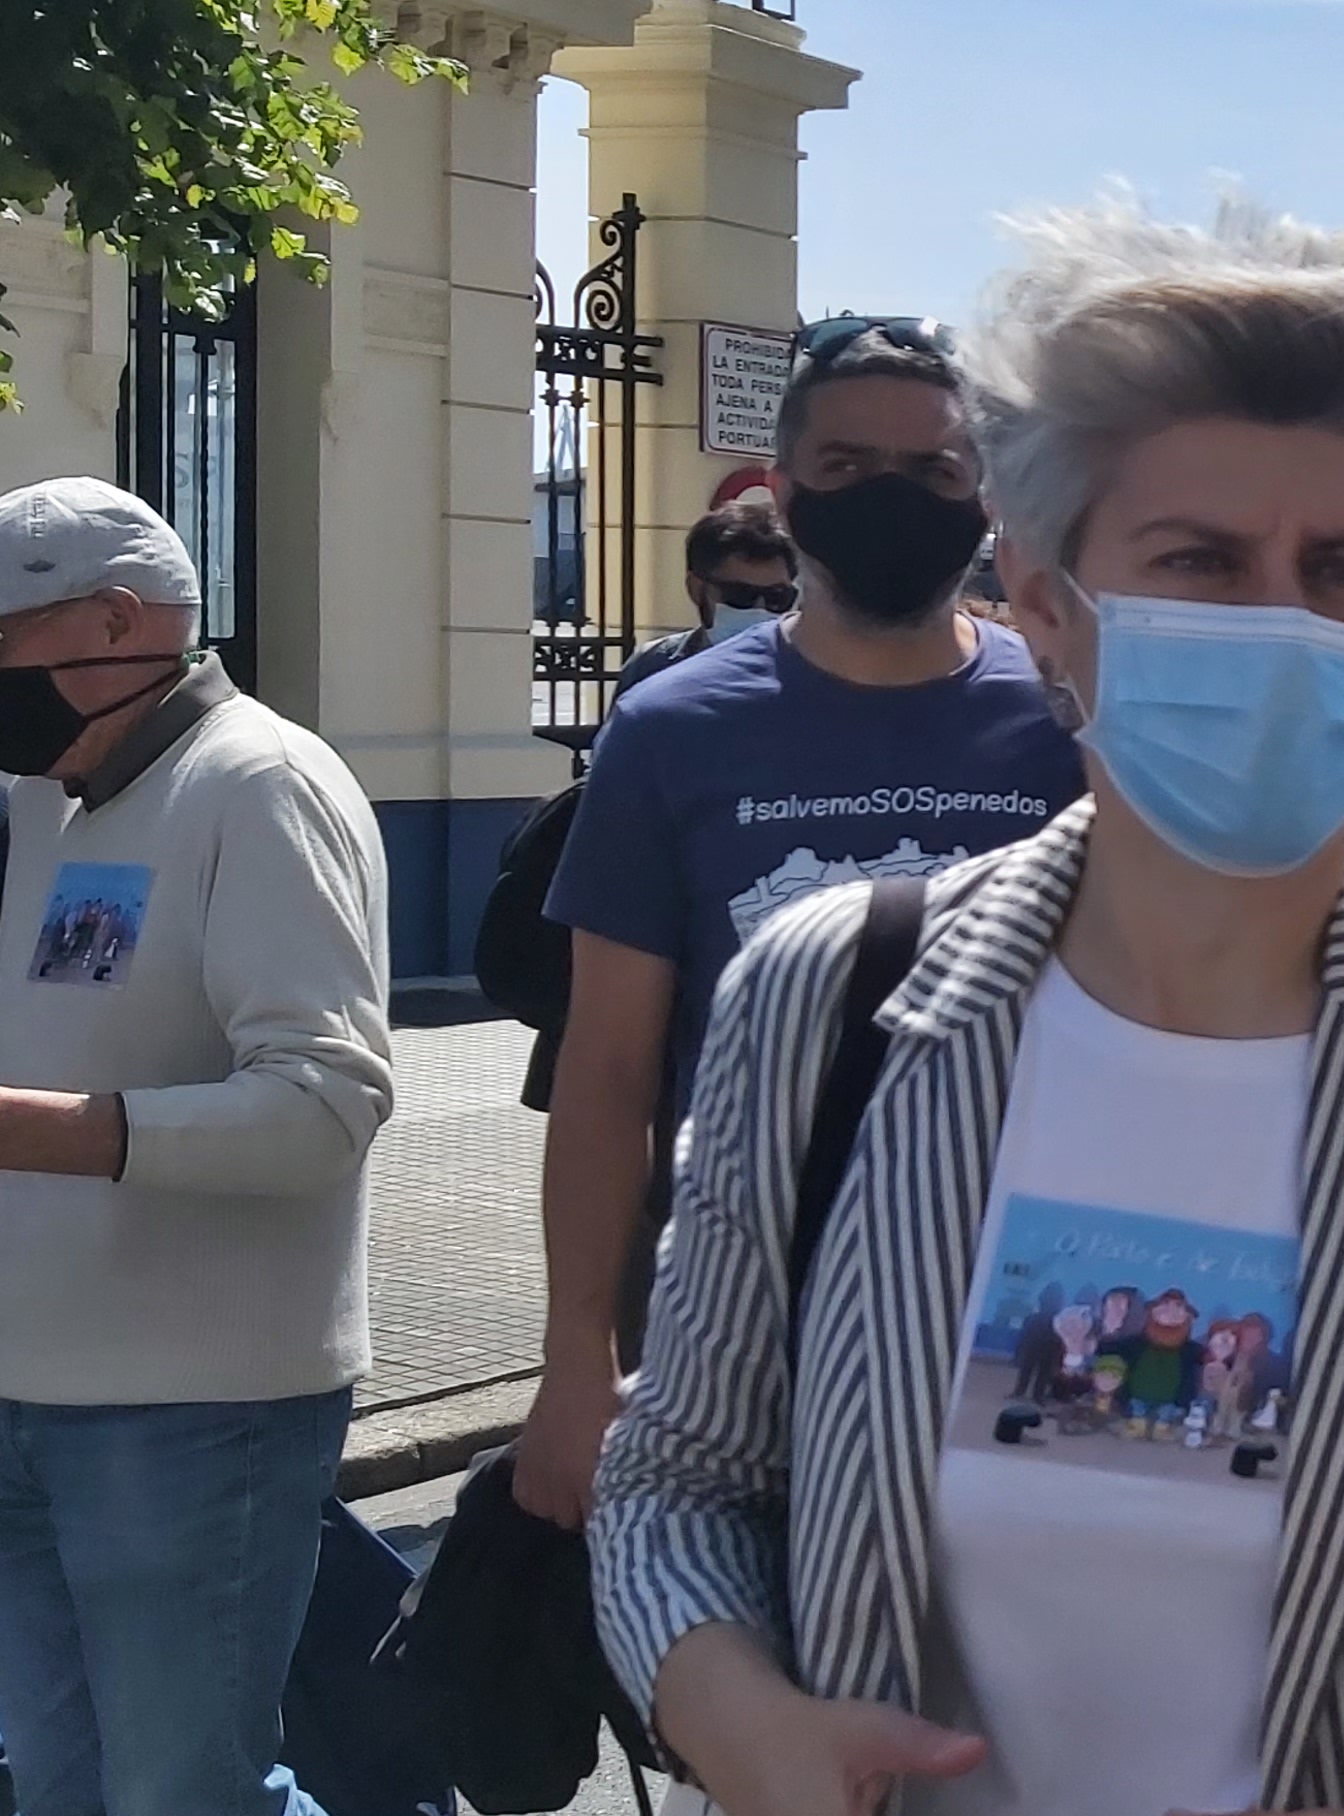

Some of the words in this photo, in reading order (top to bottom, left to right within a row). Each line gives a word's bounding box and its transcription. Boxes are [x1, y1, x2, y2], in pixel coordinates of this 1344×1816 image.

[712, 354, 728, 369] LA
[711, 373, 744, 390] TODA
[751, 378, 782, 396] PERS
[716, 393, 757, 411] AJENA
[763, 399, 773, 413] A
[717, 412, 775, 431] ACTIVIDA
[734, 785, 1048, 825] #salvemoSOSpenedos
